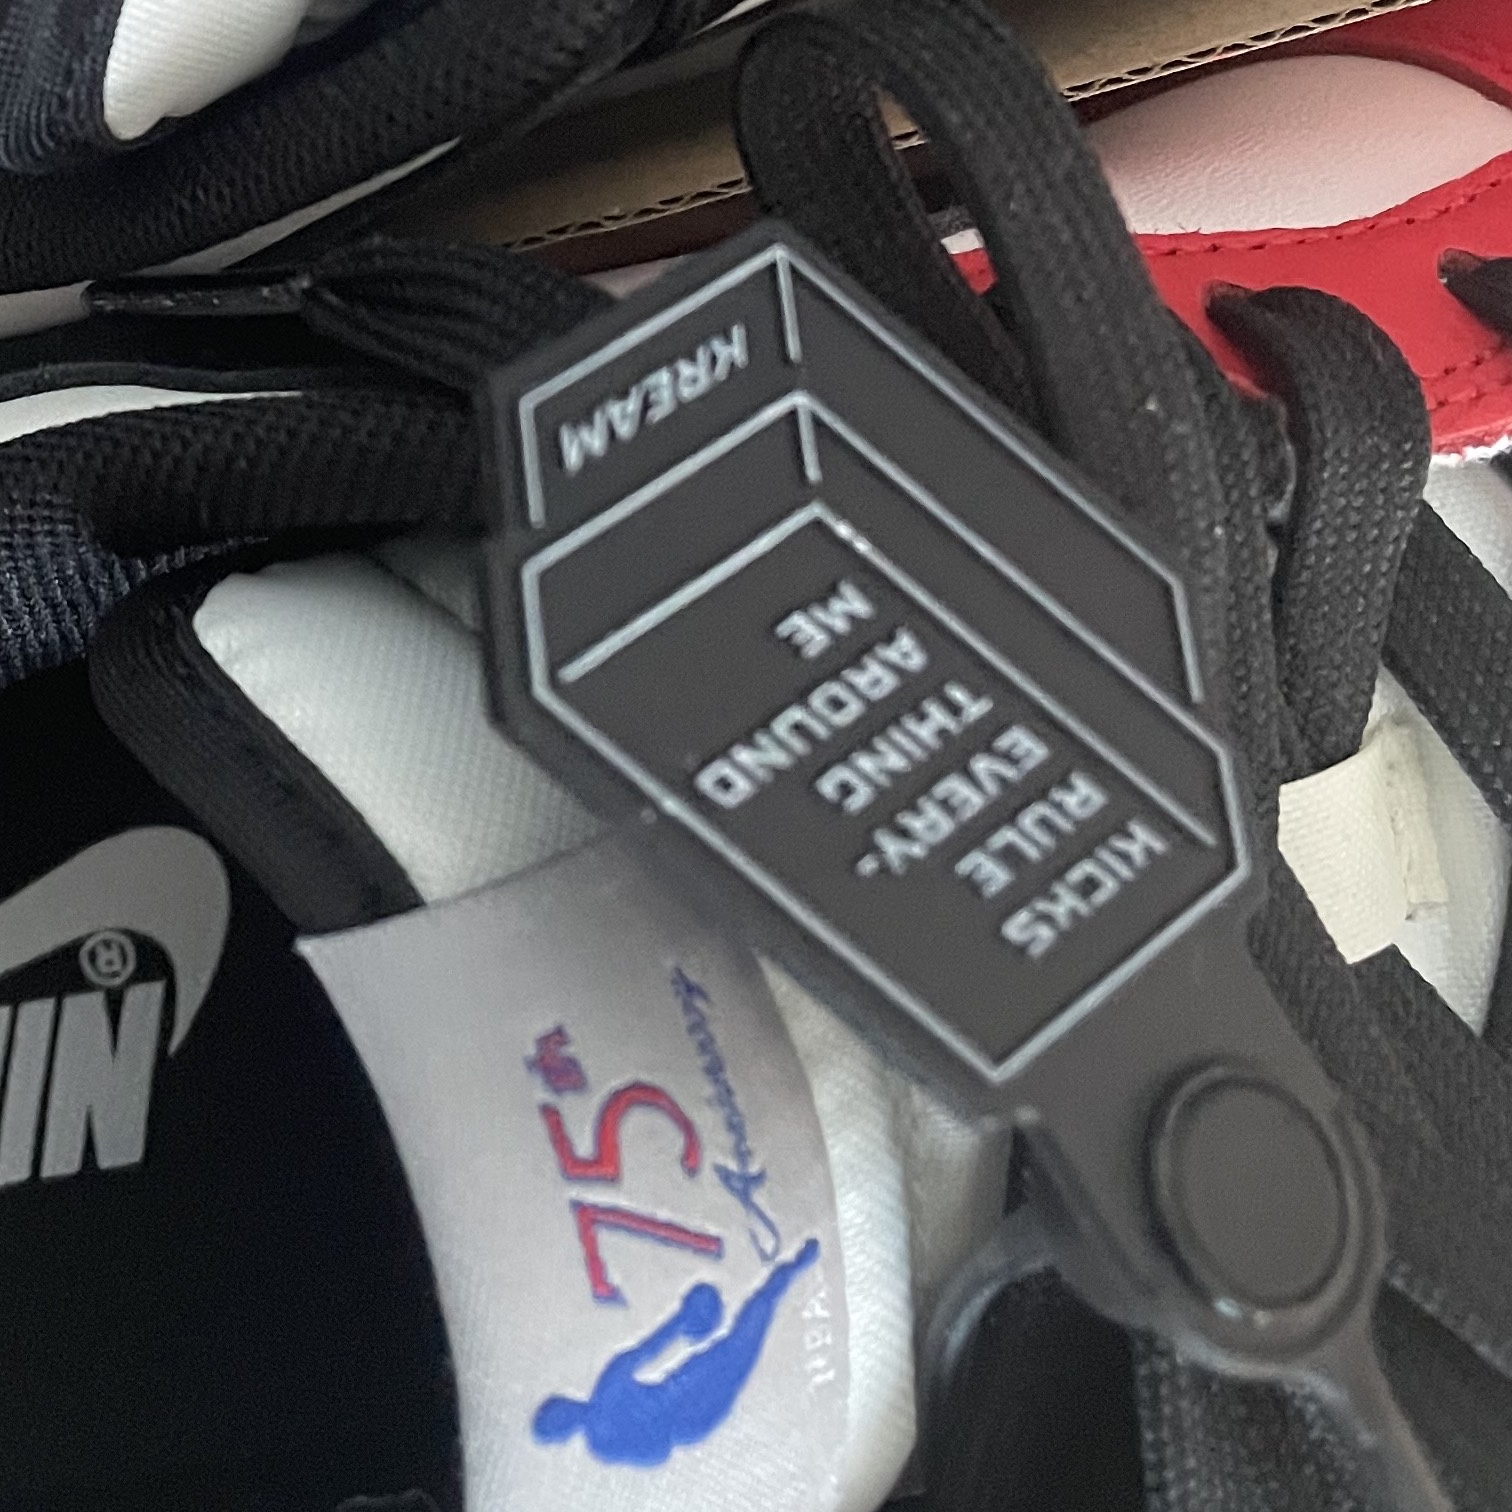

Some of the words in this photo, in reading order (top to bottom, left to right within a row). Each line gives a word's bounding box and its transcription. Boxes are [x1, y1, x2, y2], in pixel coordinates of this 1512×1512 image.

[557, 323, 749, 474] KREAM
[774, 581, 877, 660] ME
[695, 628, 929, 809] AROUND
[813, 683, 994, 816] THING
[856, 725, 1050, 877] EVERY-
[955, 771, 1108, 899] RULE
[1001, 818, 1169, 959] KICKS
